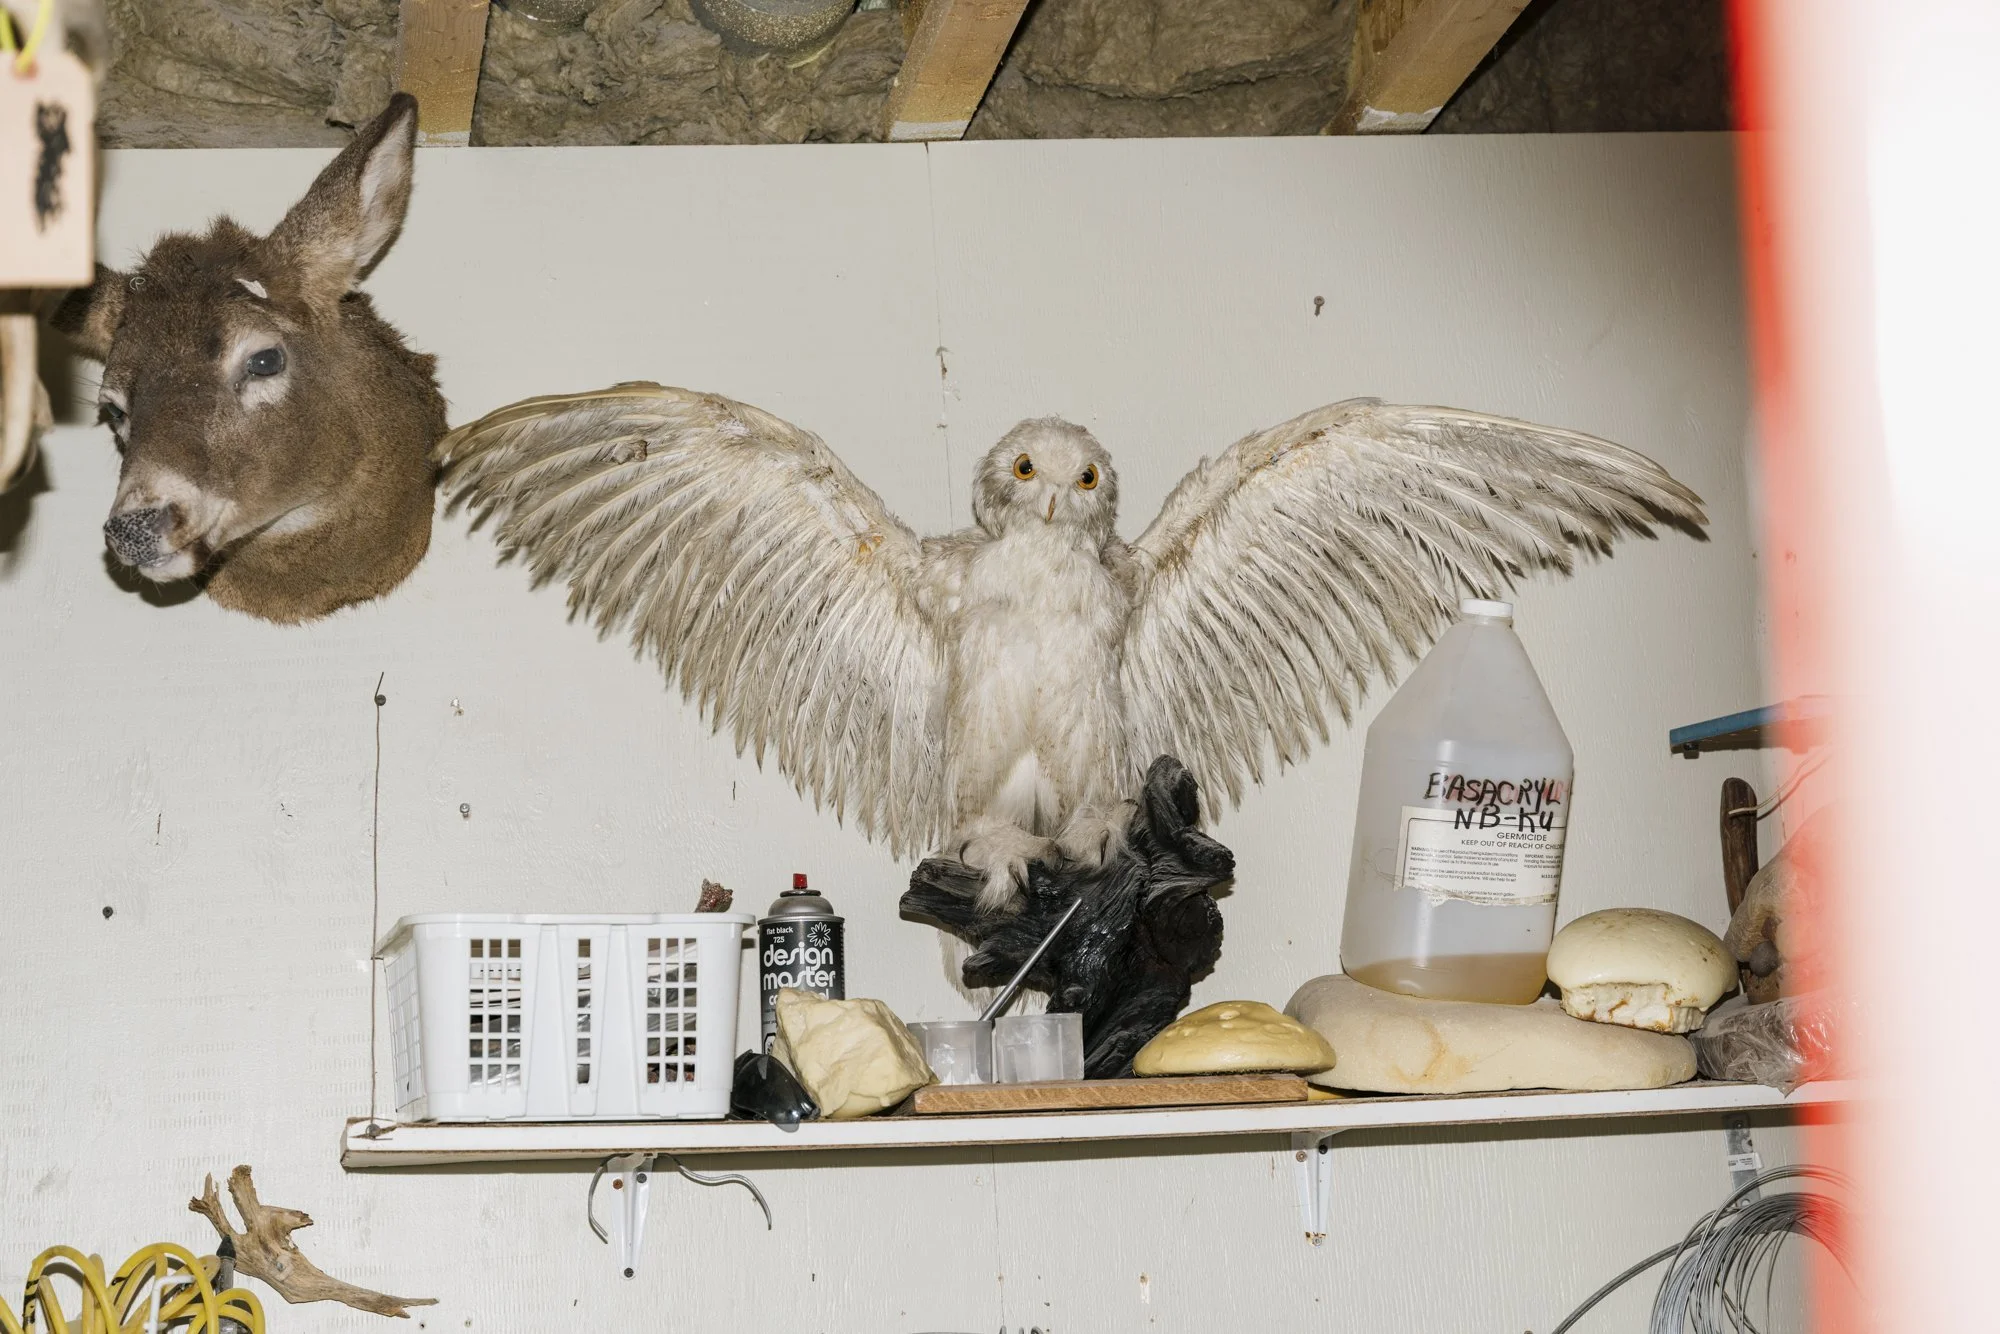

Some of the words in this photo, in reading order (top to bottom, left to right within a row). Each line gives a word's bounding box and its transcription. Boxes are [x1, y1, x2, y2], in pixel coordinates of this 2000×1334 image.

[1423, 772, 1560, 813] BASACRYL
[1496, 832, 1548, 842] GERMICIDE
[776, 926, 794, 934] black
[773, 936, 785, 944] 725
[763, 941, 834, 971] design
[763, 966, 836, 991] master
